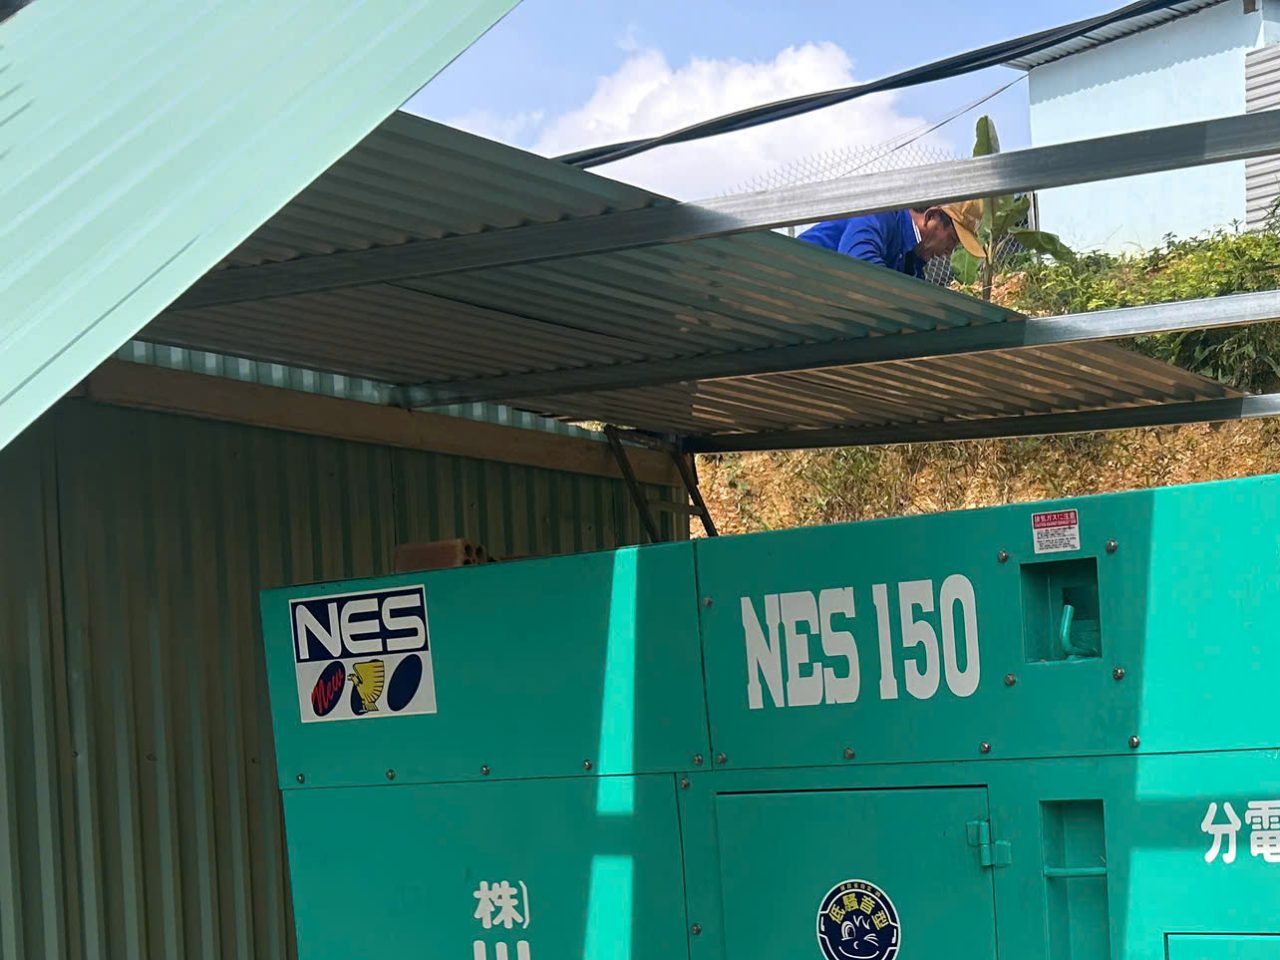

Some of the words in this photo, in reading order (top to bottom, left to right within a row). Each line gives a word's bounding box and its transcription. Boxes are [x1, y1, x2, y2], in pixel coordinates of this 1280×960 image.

[295, 593, 426, 660] NES
[740, 586, 861, 709] NES
[871, 573, 981, 700] 150
